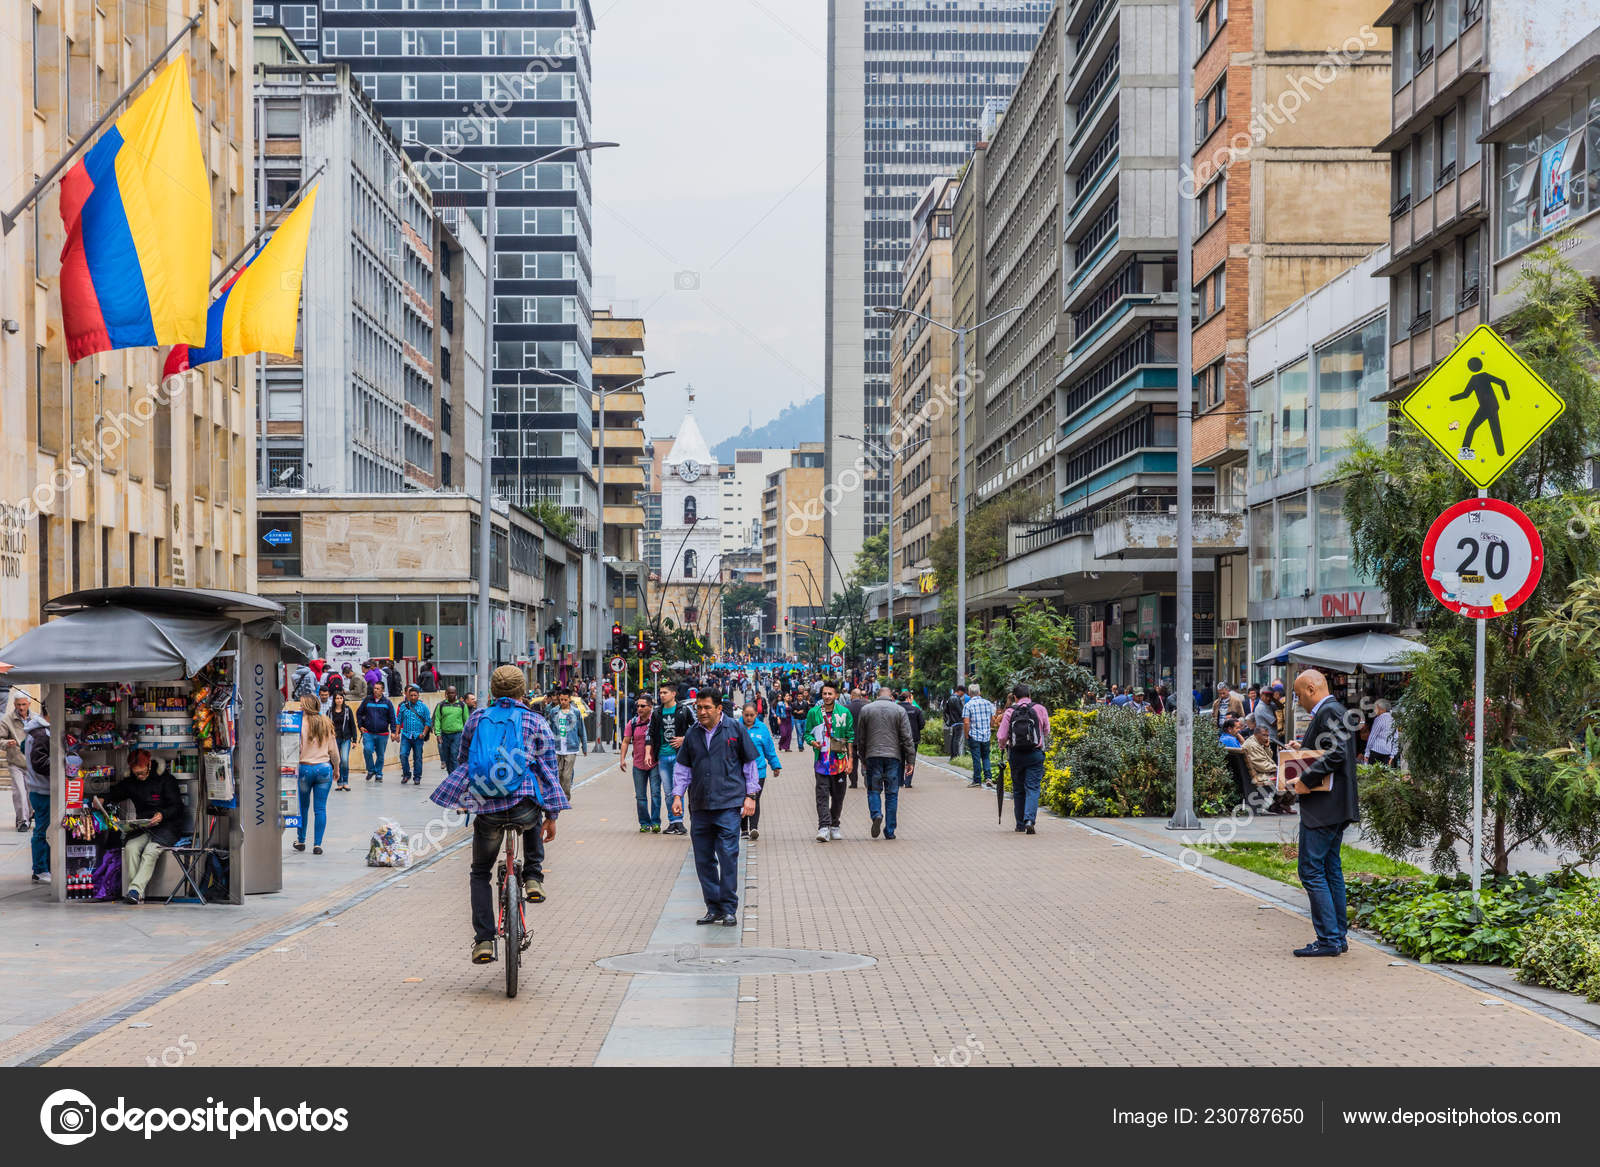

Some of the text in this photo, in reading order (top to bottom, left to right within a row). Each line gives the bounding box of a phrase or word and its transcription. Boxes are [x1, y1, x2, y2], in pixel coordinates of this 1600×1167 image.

[1, 556, 20, 579] TORO
[1456, 537, 1510, 580] 20
[1321, 591, 1366, 617] ONLY
[833, 712, 847, 728] M
[252, 664, 267, 827] www.ipes.gov.co
